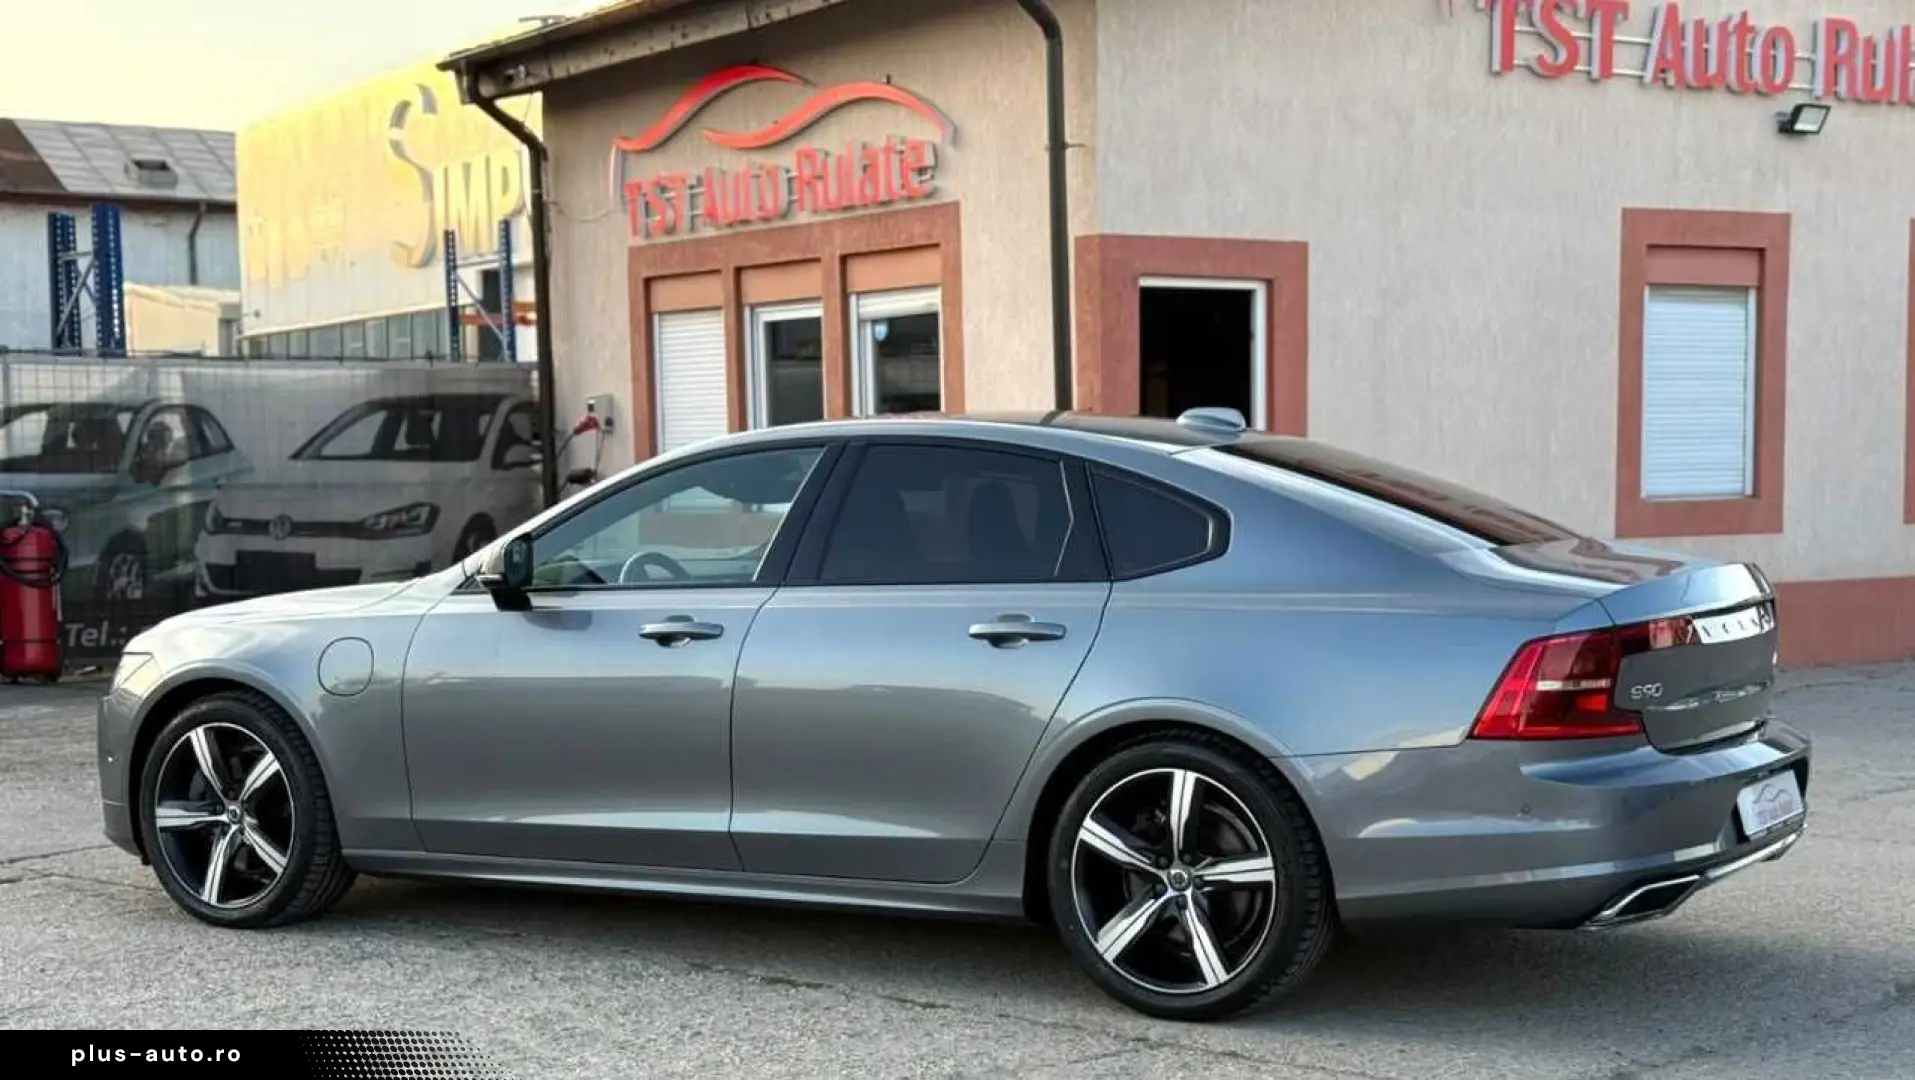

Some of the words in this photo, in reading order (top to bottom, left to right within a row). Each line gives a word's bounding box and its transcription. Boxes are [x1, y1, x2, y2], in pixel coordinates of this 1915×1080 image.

[1483, 0, 1629, 80] TST
[1646, 2, 1796, 96] Auto
[1817, 16, 1915, 105] Rul
[624, 175, 689, 238] TST
[704, 164, 786, 226] Auto
[794, 134, 936, 214] Rulate
